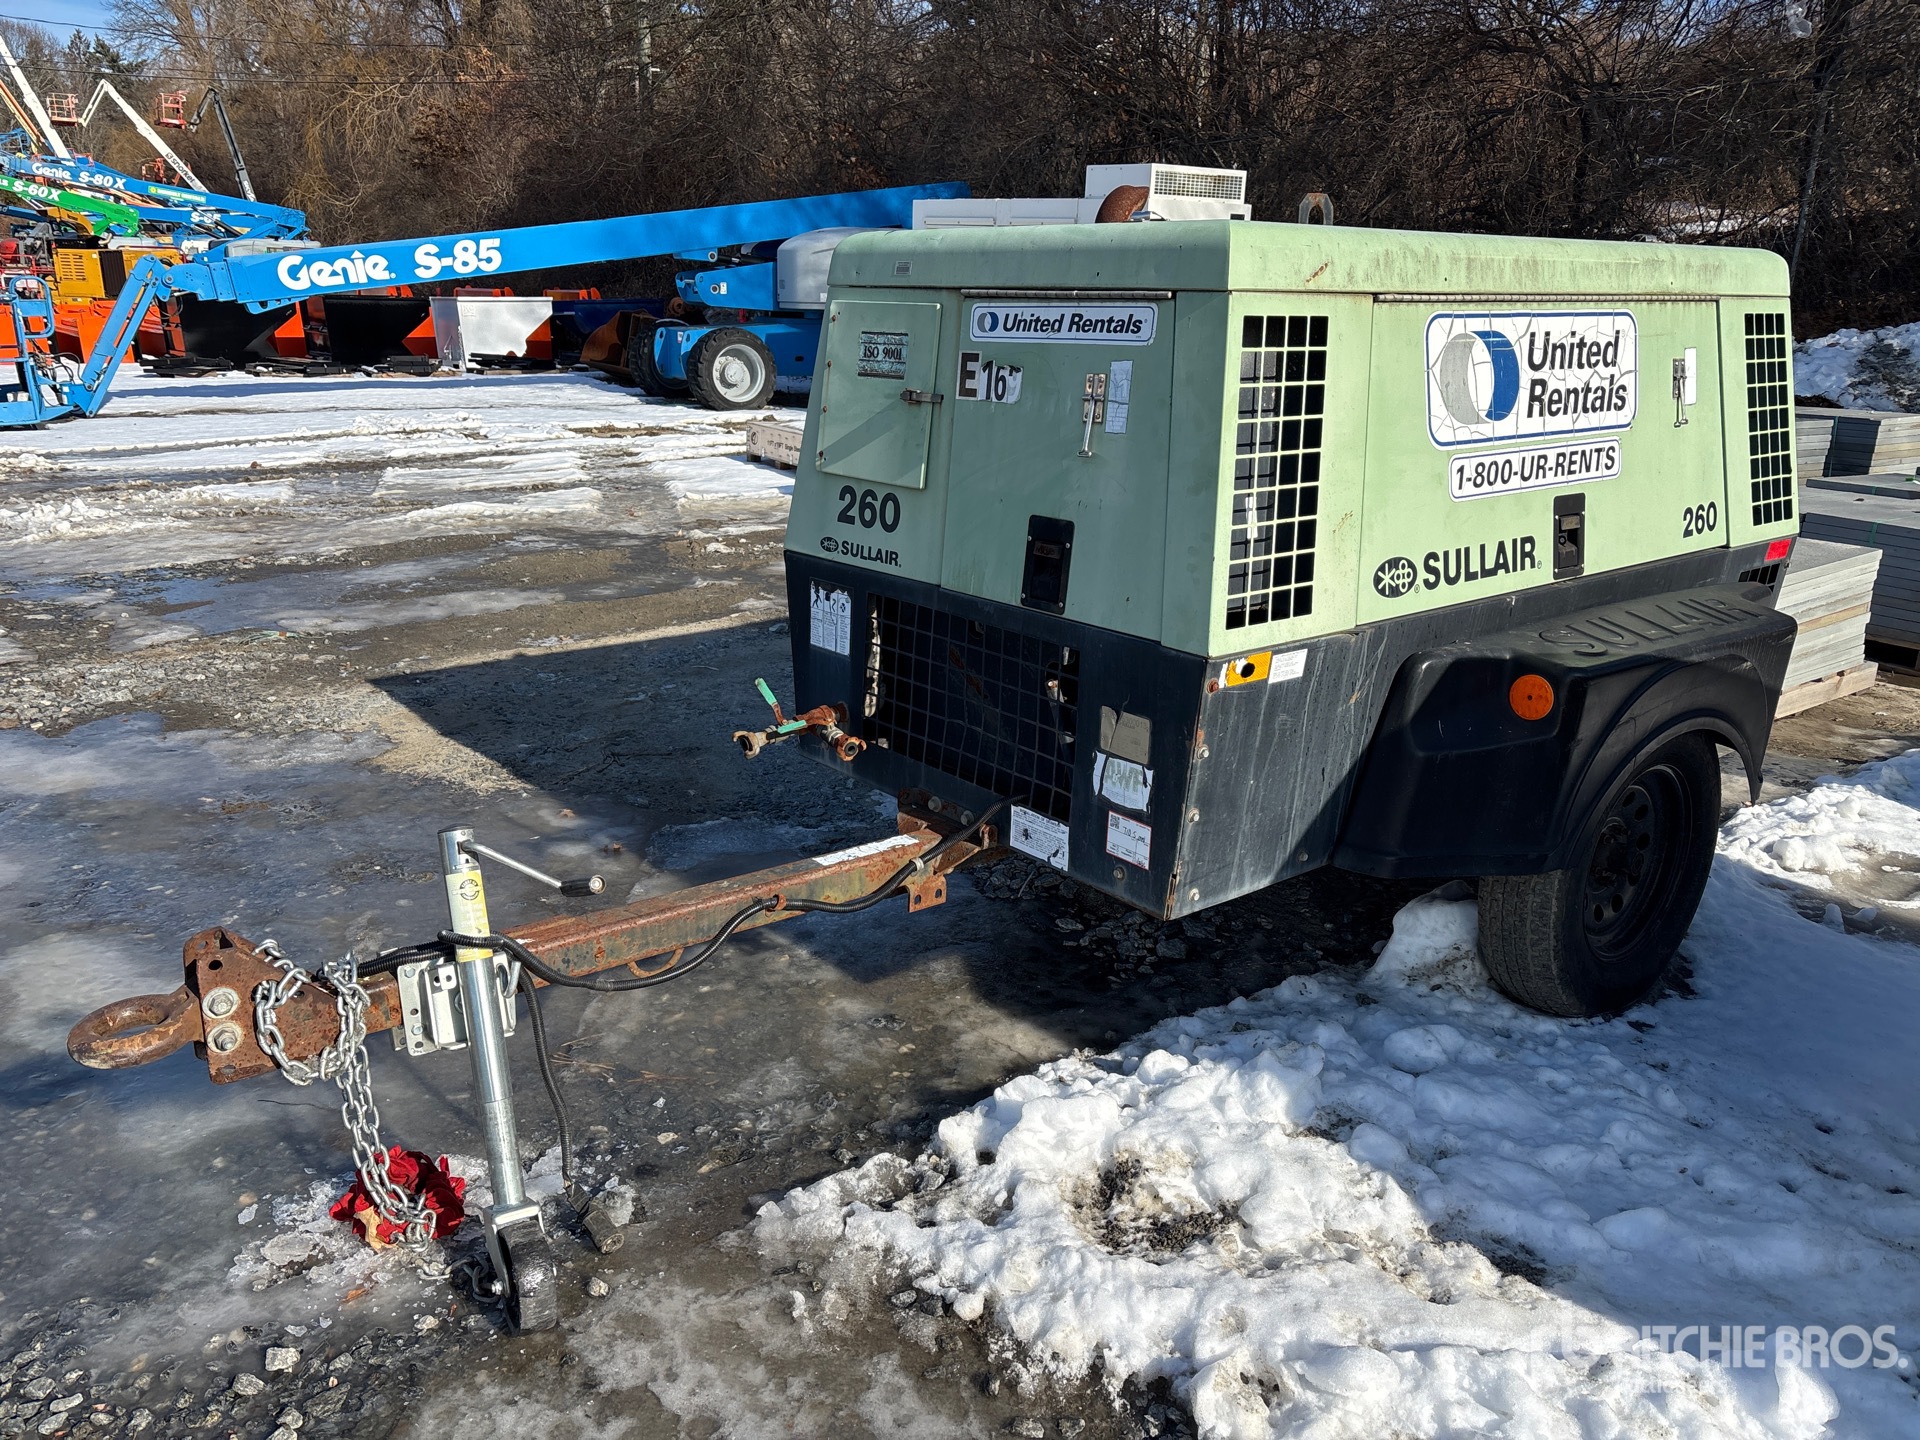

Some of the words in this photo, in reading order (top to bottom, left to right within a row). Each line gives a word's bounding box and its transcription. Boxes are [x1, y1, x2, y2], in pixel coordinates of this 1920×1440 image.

[32, 162, 73, 180] Genie
[169, 157, 196, 184] snorkel
[277, 250, 390, 290] Genie
[413, 237, 503, 279] S-85
[1002, 312, 1065, 333] United
[1067, 313, 1144, 334] Rentals
[862, 344, 880, 359] ISO
[882, 346, 903, 361] 9001
[1527, 329, 1621, 372] United
[1526, 374, 1628, 419] Rentals
[1455, 445, 1617, 491] 1-800-UR-RENTS
[837, 484, 902, 534] 260
[1682, 500, 1718, 538] 260
[840, 539, 901, 567] SULLAIR
[1422, 535, 1536, 591] SULLAIR
[1538, 597, 1764, 657] SULLAIR
